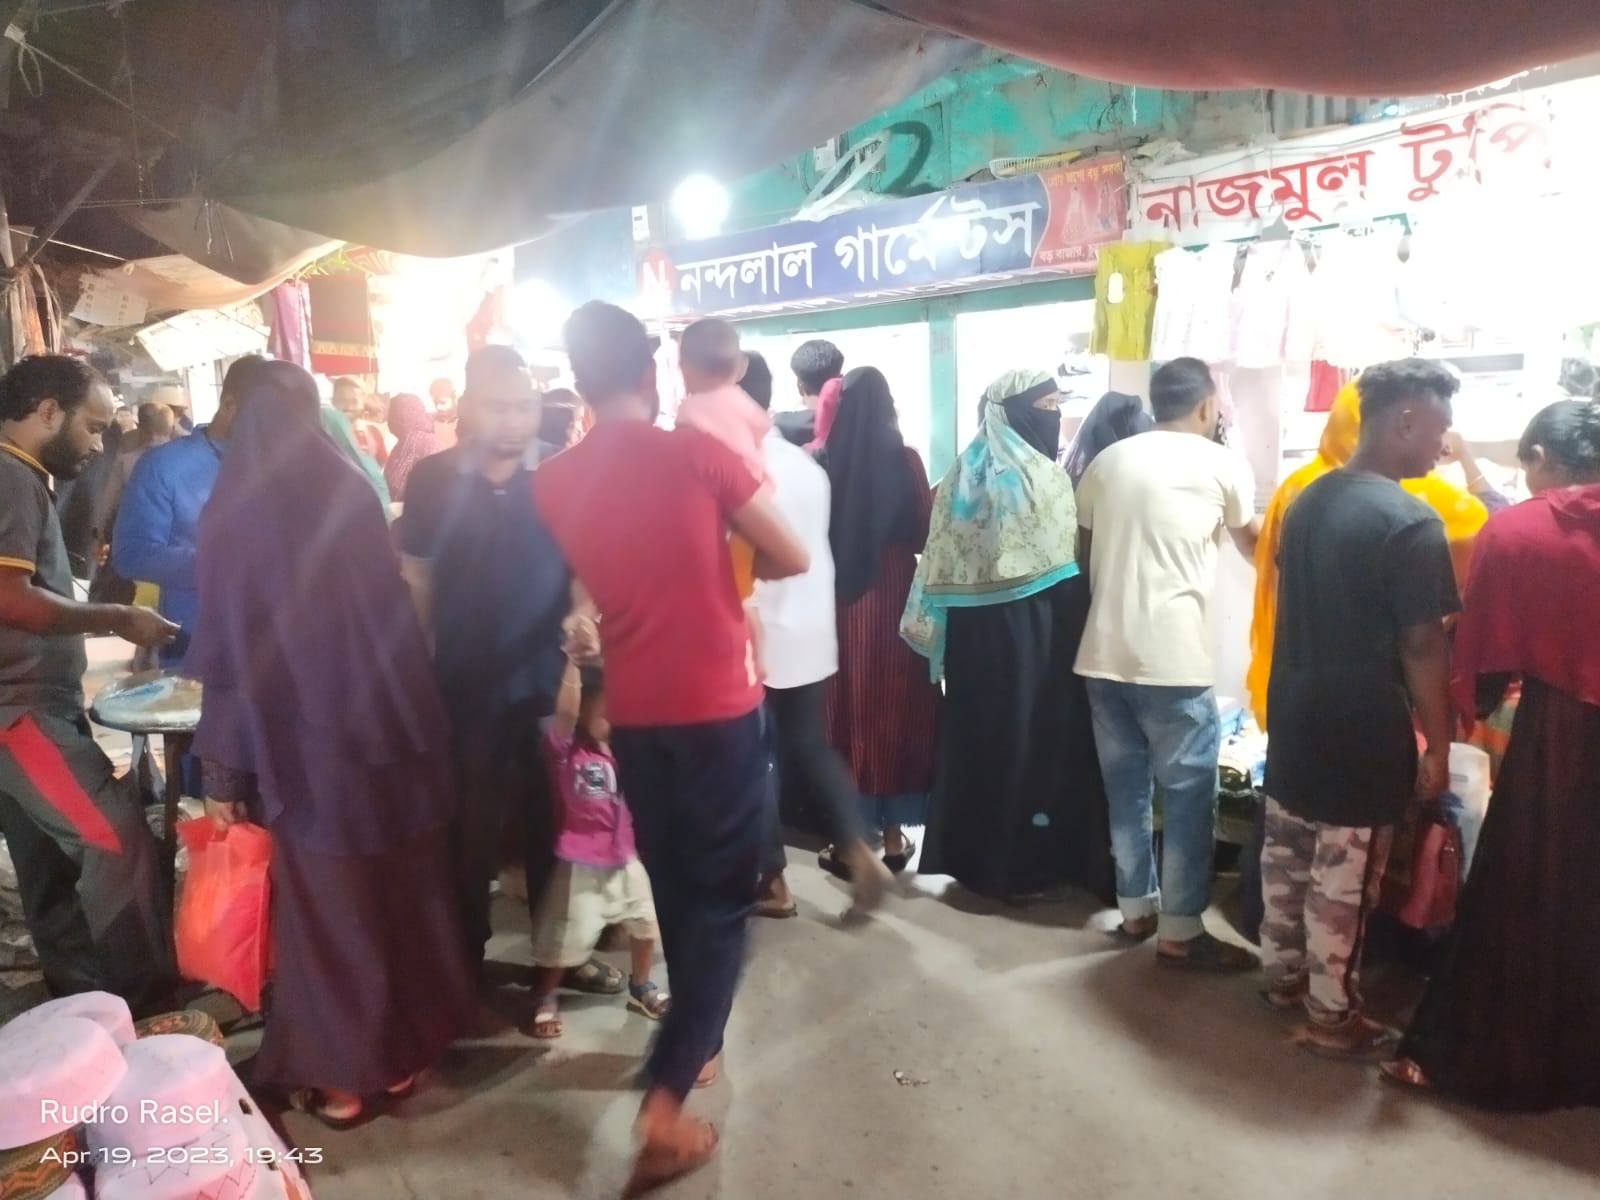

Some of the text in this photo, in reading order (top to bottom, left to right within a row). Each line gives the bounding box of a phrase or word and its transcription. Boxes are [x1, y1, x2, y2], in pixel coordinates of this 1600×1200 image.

[1139, 149, 1376, 232] নাজমুল
[674, 195, 1043, 303] নন্দলাল গার্মেটস
